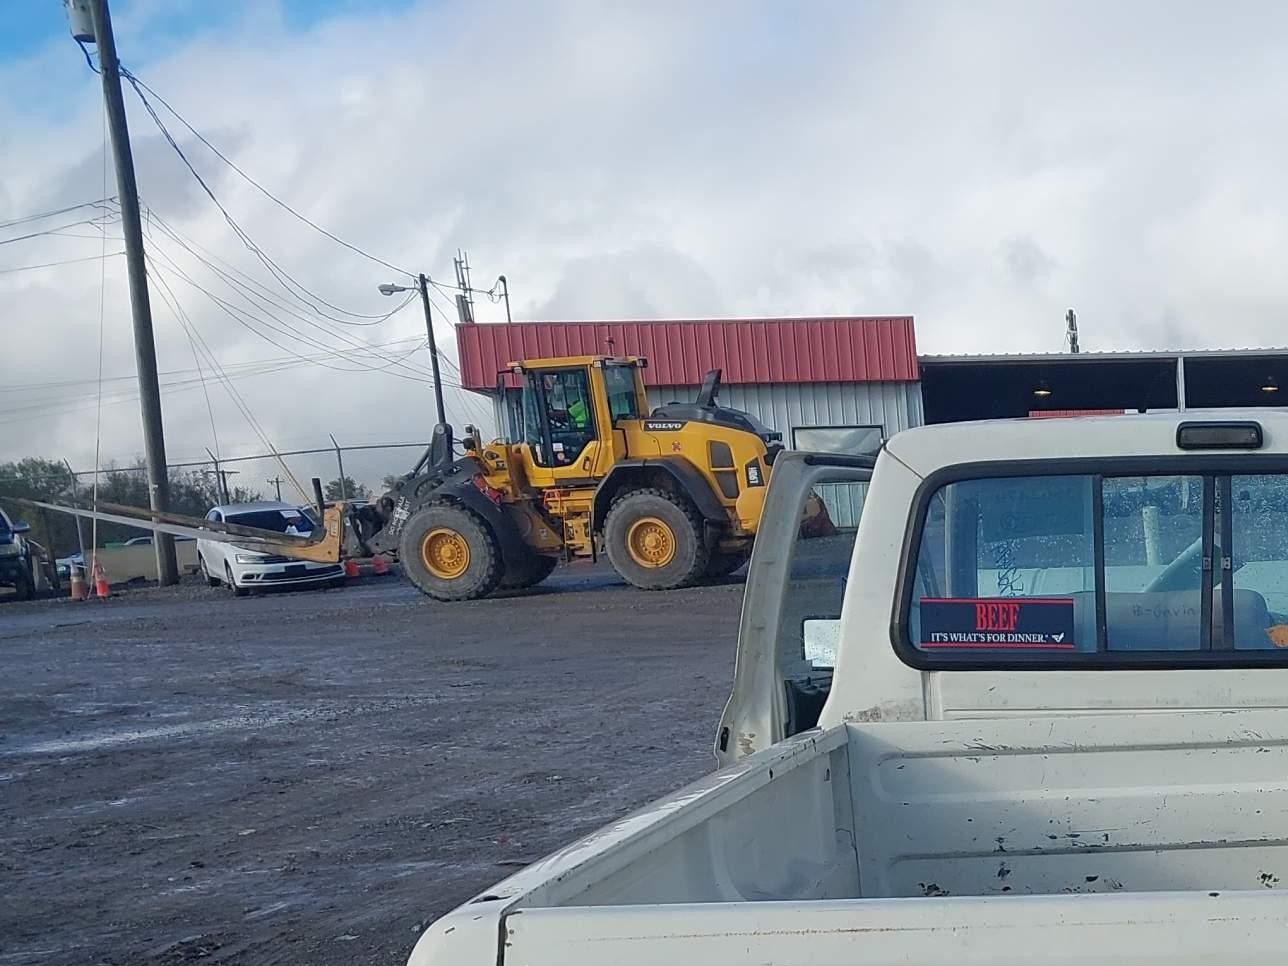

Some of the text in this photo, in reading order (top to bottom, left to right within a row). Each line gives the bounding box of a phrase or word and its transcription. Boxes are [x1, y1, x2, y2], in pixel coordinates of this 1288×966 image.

[975, 603, 1022, 631] BEEF
[931, 632, 949, 642] IT'S
[949, 632, 986, 643] WHAT'S
[987, 633, 1008, 643] FOR
